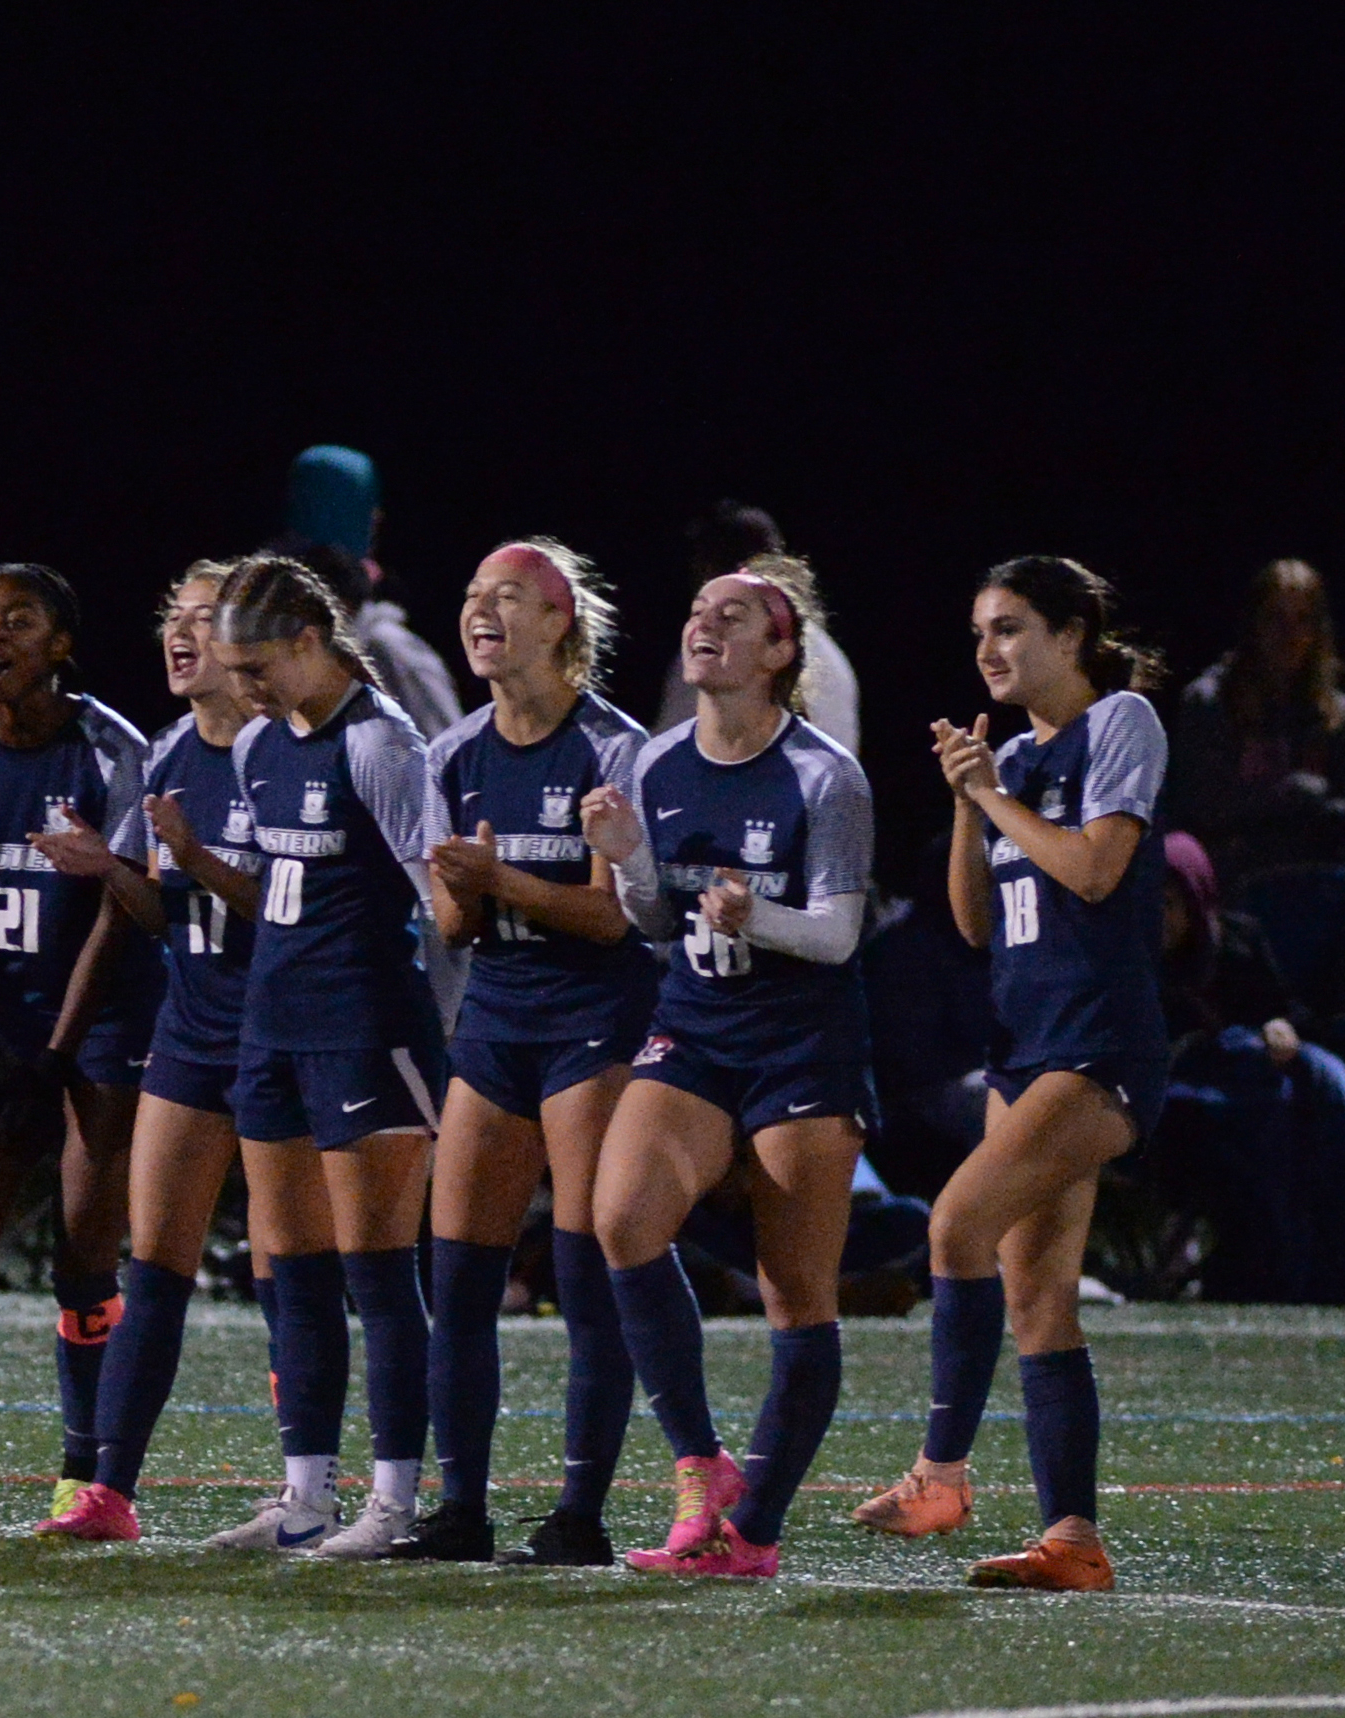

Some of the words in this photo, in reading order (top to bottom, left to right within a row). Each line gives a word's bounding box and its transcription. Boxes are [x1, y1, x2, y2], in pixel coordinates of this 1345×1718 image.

[264, 858, 304, 925] 10
[1000, 876, 1040, 948] 18
[77, 1306, 110, 1339] C
